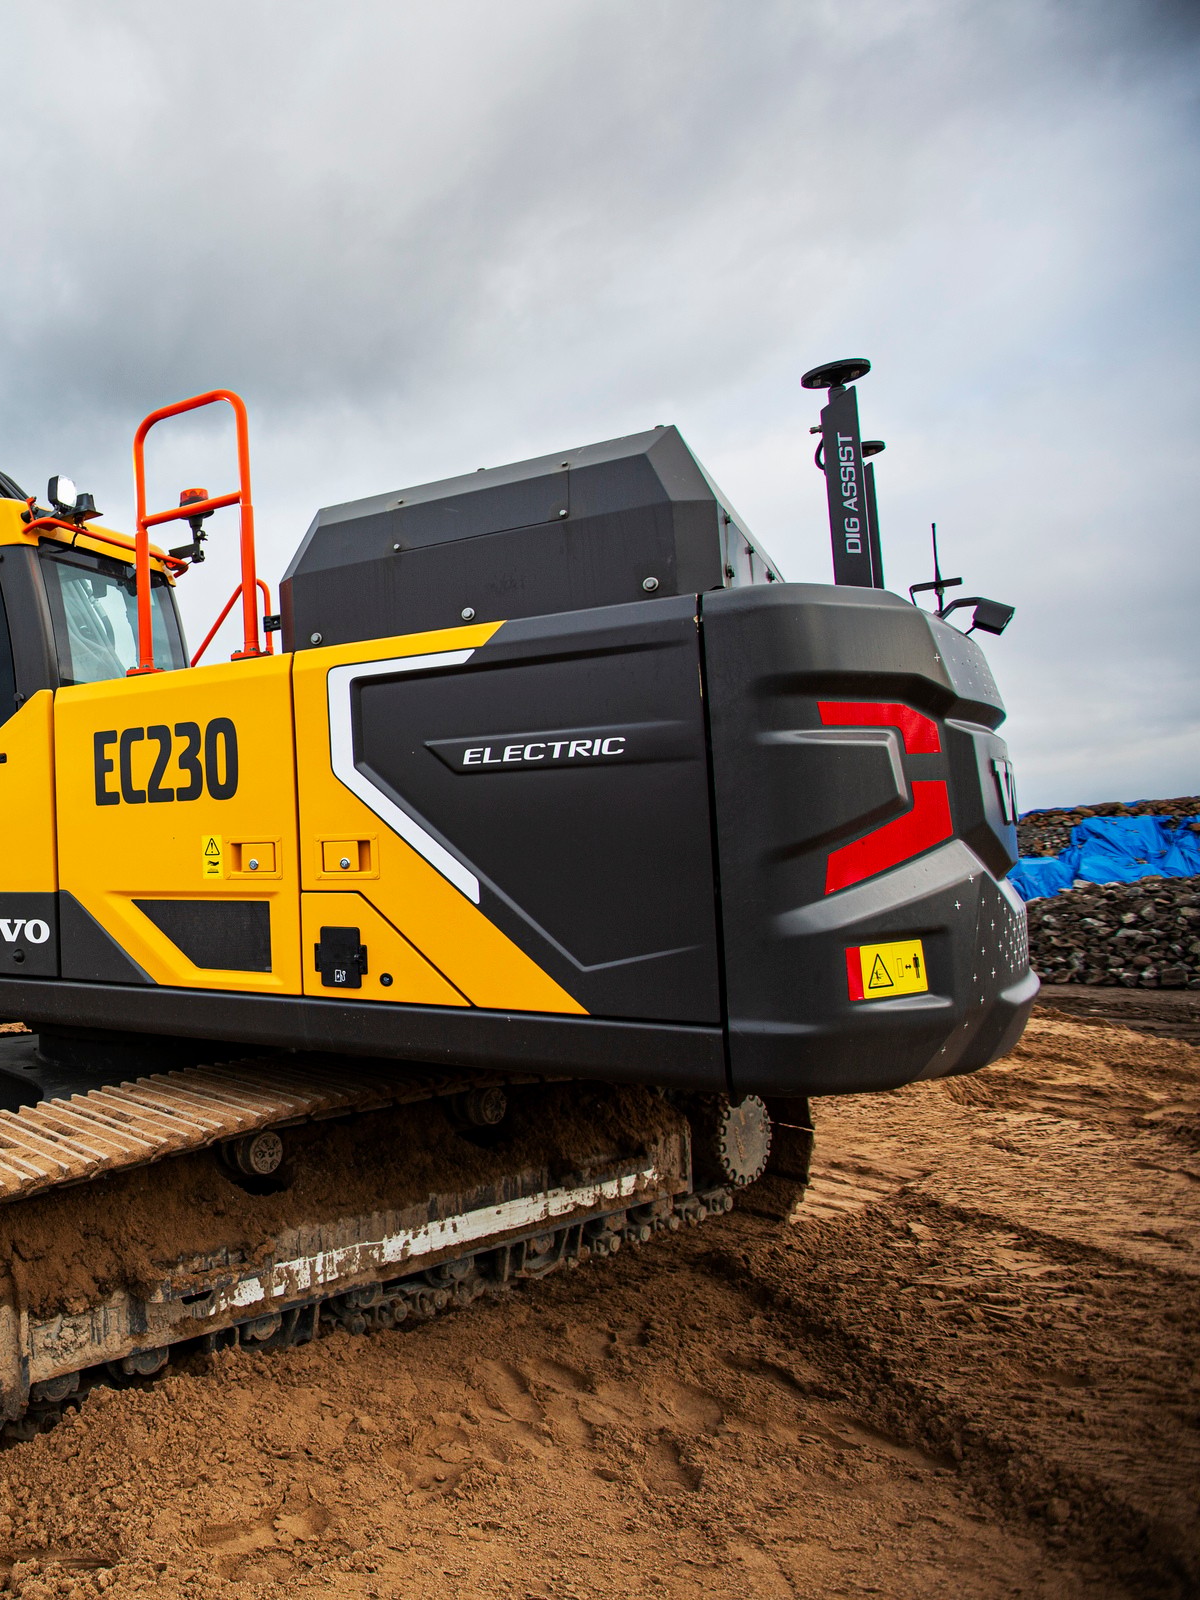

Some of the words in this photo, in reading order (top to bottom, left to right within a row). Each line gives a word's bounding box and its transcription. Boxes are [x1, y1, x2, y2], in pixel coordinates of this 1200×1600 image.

[837, 432, 859, 512] ASSIST
[844, 517, 862, 554] DIG
[94, 717, 239, 806] EC230
[462, 737, 626, 765] ELECTRIC
